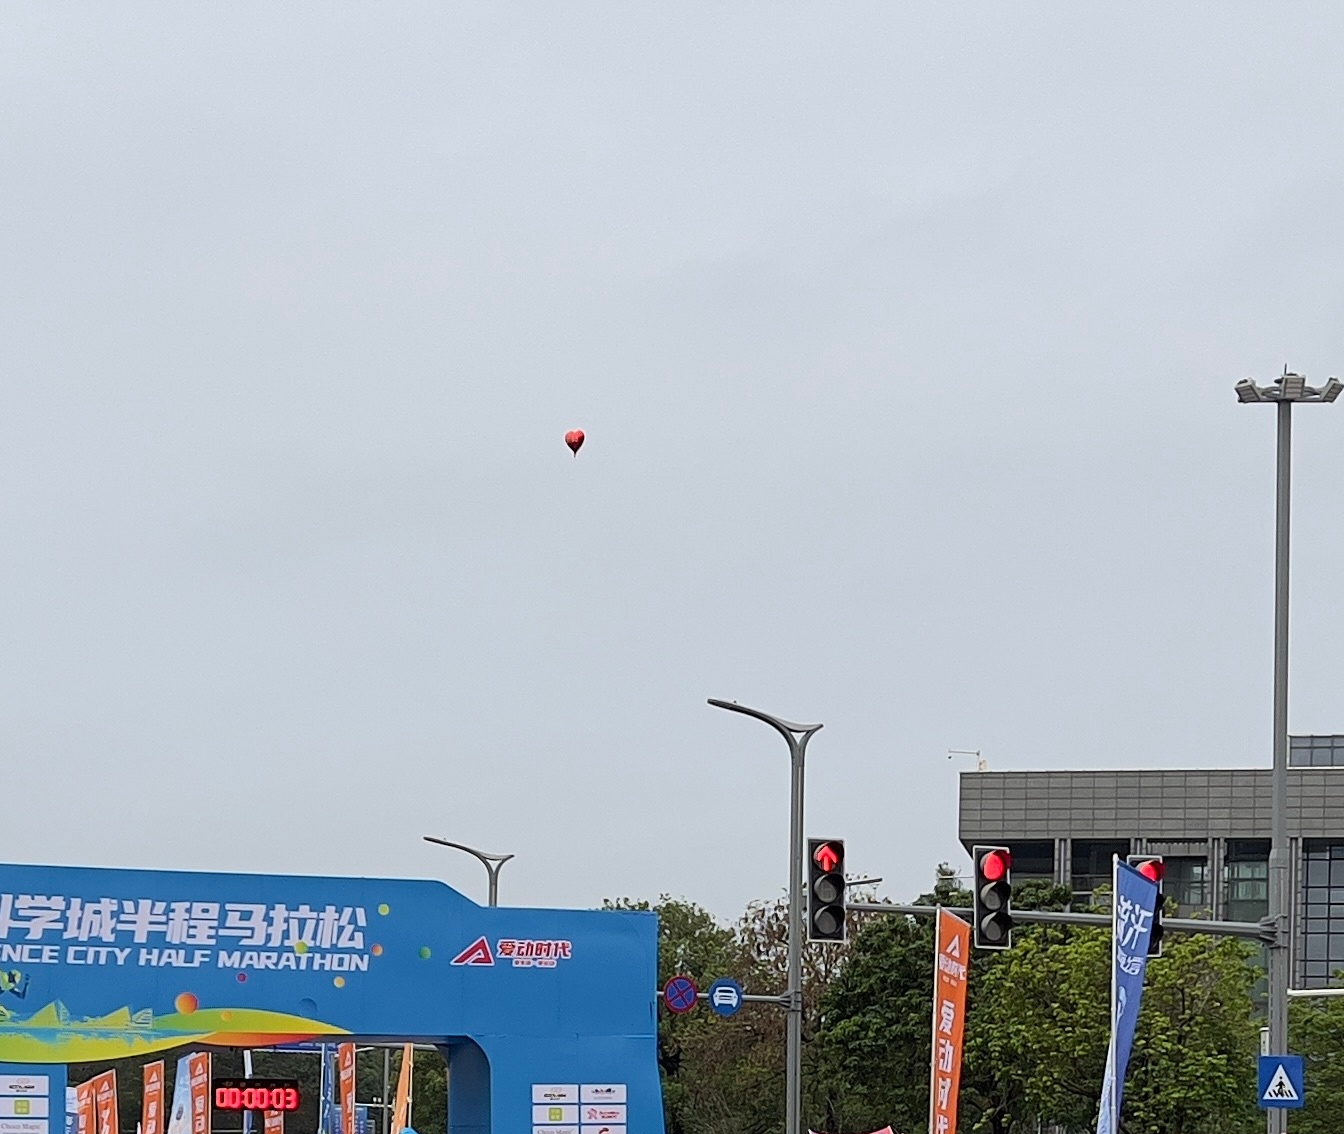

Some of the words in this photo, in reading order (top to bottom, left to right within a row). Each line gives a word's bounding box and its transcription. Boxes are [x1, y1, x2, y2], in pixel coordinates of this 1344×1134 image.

[66, 946, 131, 965] CITY
[138, 948, 210, 968] HALF
[217, 951, 369, 972] MARATHON
[499, 941, 570, 957] 爱动时代
[216, 1088, 296, 1109] 00:00:03
